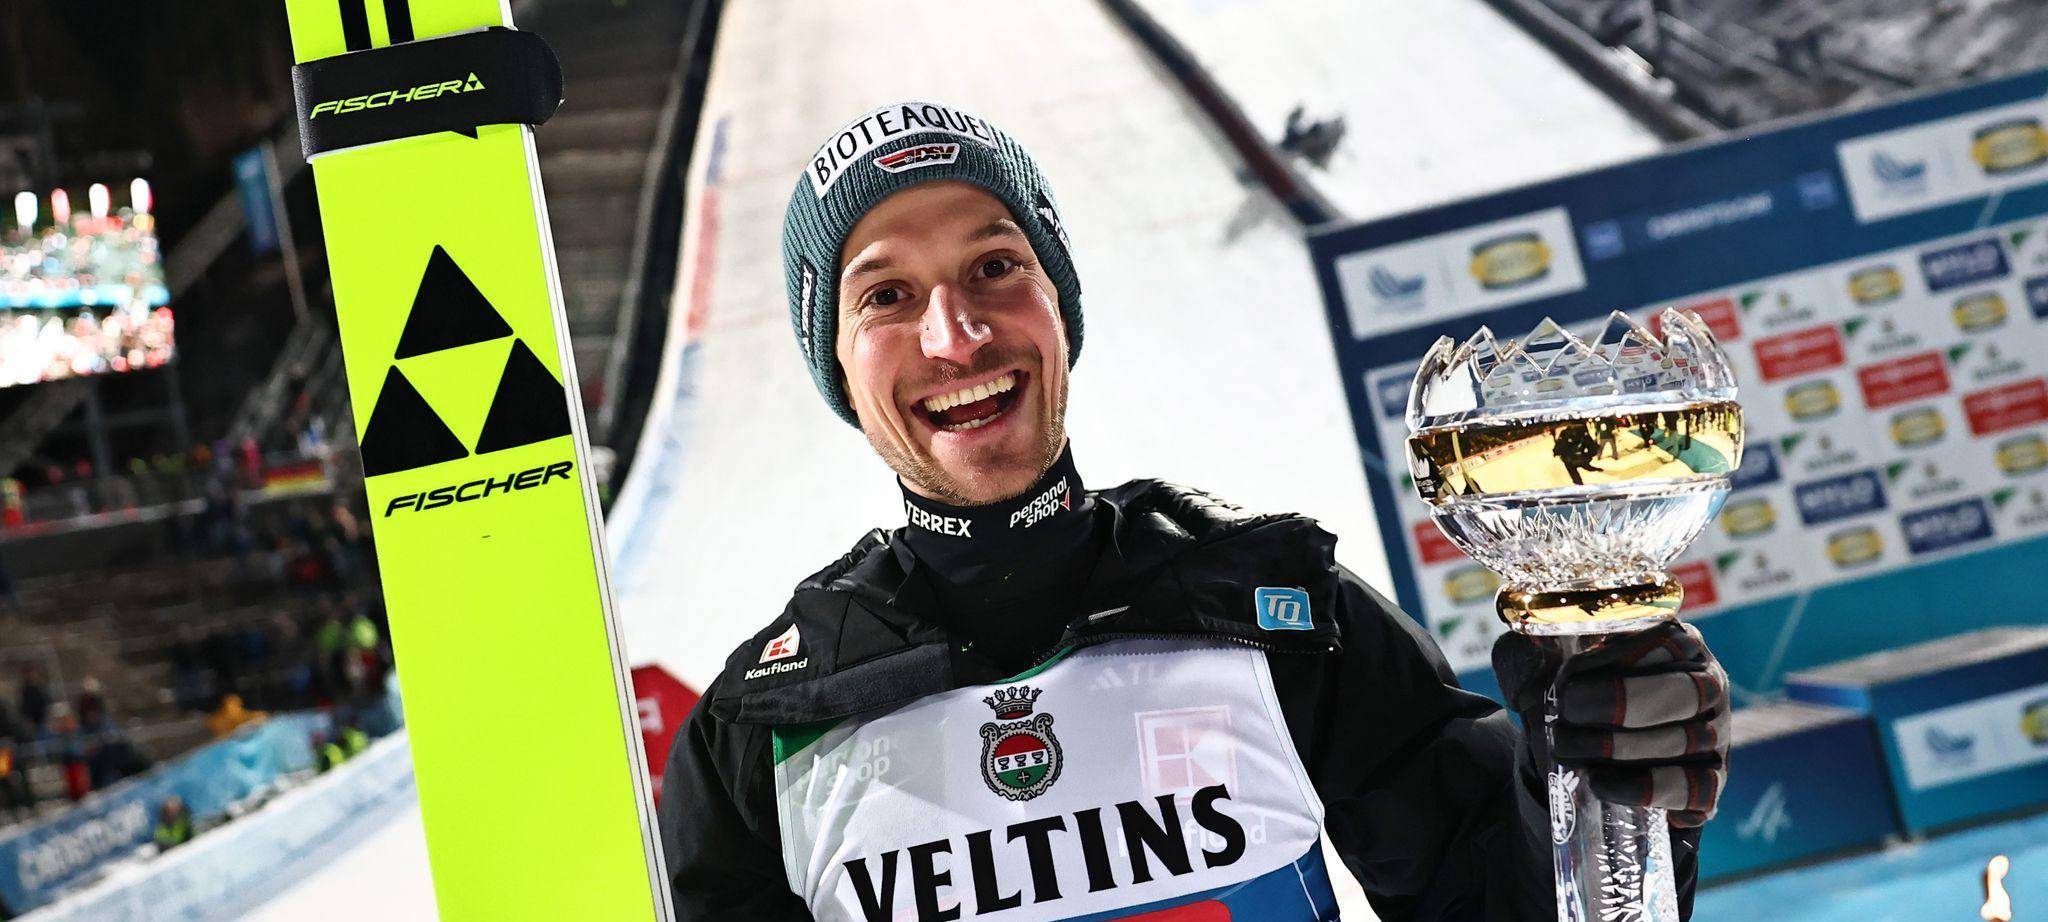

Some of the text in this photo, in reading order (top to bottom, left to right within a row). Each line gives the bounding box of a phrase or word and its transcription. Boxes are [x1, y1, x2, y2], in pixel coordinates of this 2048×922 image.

[309, 79, 463, 120] FISCHER
[814, 104, 991, 186] BIOTEAQUE
[915, 146, 956, 162] DSV
[384, 460, 574, 518] FISCHER
[1010, 475, 1068, 528] personal
[905, 499, 972, 538] TERREX
[1025, 498, 1060, 528] shop
[1263, 594, 1305, 626] TQ
[744, 657, 808, 681] Kaufland
[842, 784, 1246, 922] VELTINS
